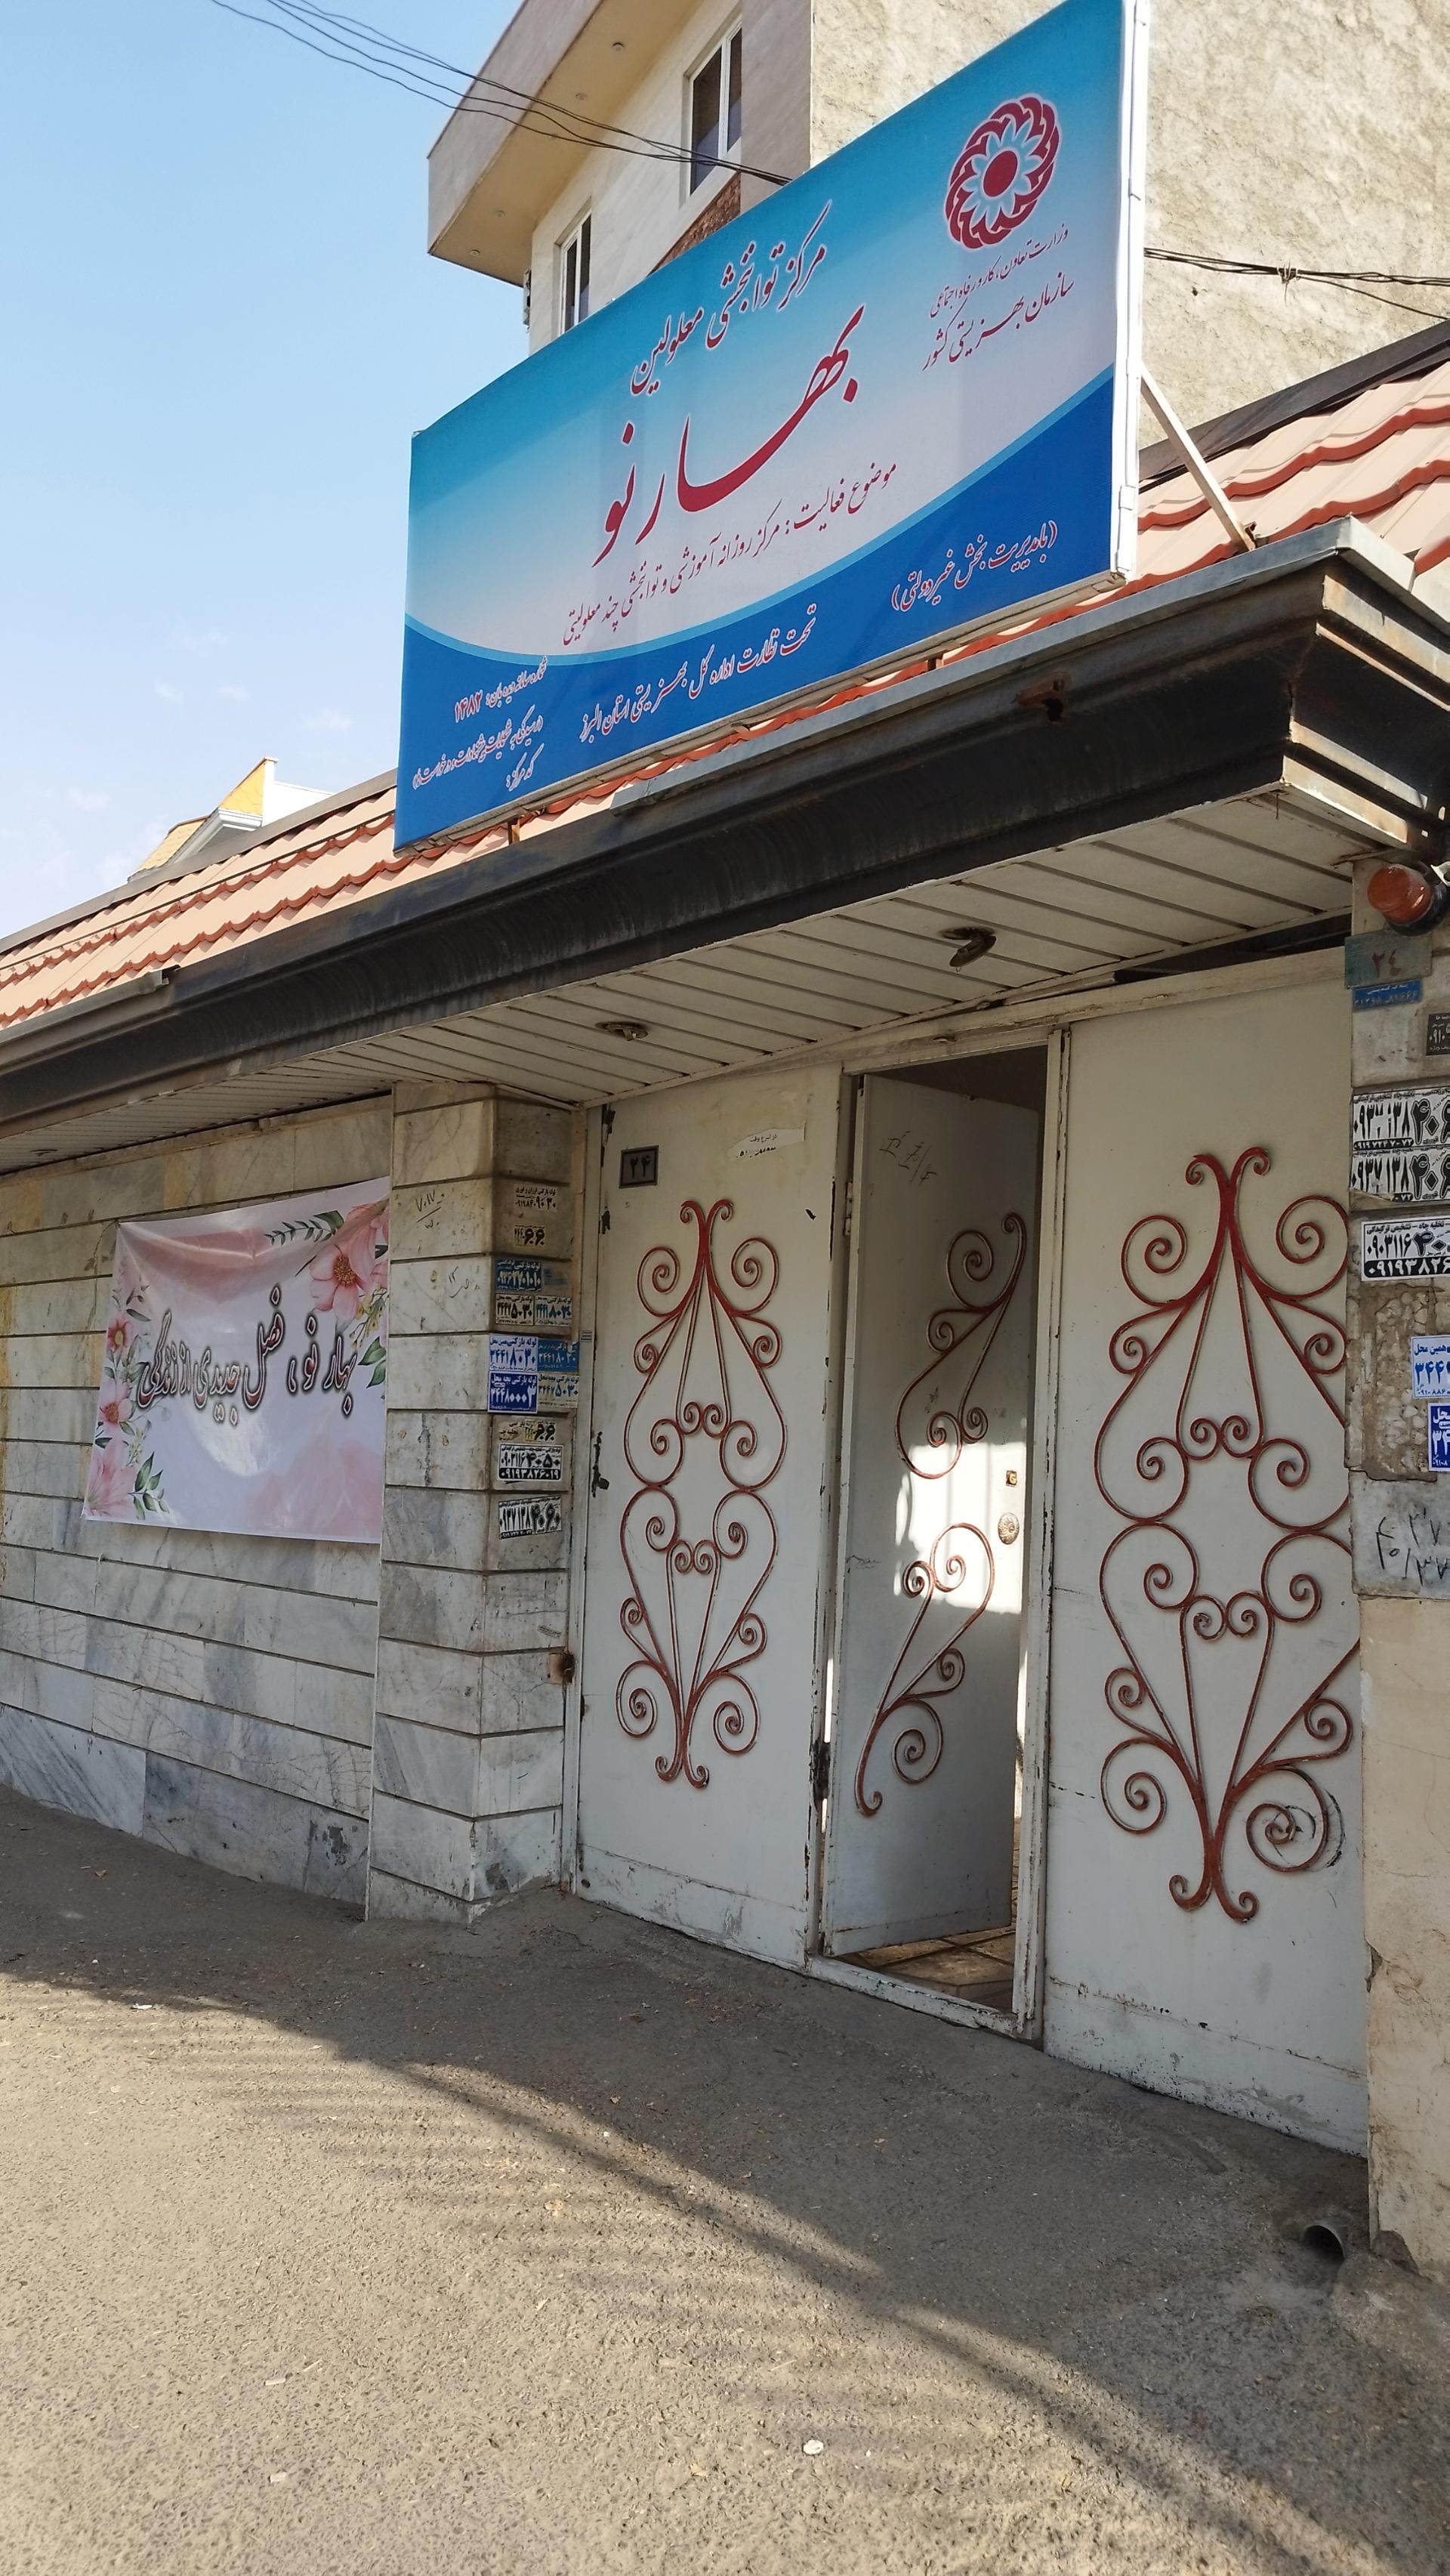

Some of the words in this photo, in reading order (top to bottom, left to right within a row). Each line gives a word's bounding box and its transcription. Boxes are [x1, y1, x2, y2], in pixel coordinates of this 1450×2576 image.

[777, 199, 833, 312] مرکز
[1028, 224, 1069, 258] وزارت
[705, 240, 785, 350] توانبخشی
[958, 275, 976, 299] رفاه
[984, 255, 1001, 283] کار
[930, 283, 958, 318] اجتماعی
[1025, 271, 1075, 323] سازمان
[630, 307, 704, 397] معلولین
[922, 297, 967, 371] کشور
[949, 295, 1025, 363] بهزیستی
[634, 303, 866, 545] بهار
[591, 420, 635, 568] نو
[847, 462, 897, 515] موضوع
[717, 533, 752, 567] روزانه
[753, 499, 782, 558] مرکز
[669, 531, 721, 595] آموزشی
[955, 534, 987, 589] بخش
[602, 595, 619, 632] چند
[621, 561, 661, 619] توانبخشی
[562, 604, 601, 647] معلولیتی
[737, 628, 780, 672] نظارت
[780, 603, 817, 657] تحت
[631, 660, 689, 724] بهزیستی
[689, 644, 715, 700] کل
[709, 654, 736, 685] اداره
[579, 703, 603, 743] البرز
[602, 694, 630, 736] استان
[629, 1156, 652, 1180] ۲۴
[136, 1308, 180, 1410] زندگی
[179, 1341, 192, 1396] از
[244, 1284, 285, 1410] فصل
[322, 1327, 358, 1416] بهار
[1414, 1343, 1428, 1356] محل
[193, 1346, 242, 1427] جدیدی
